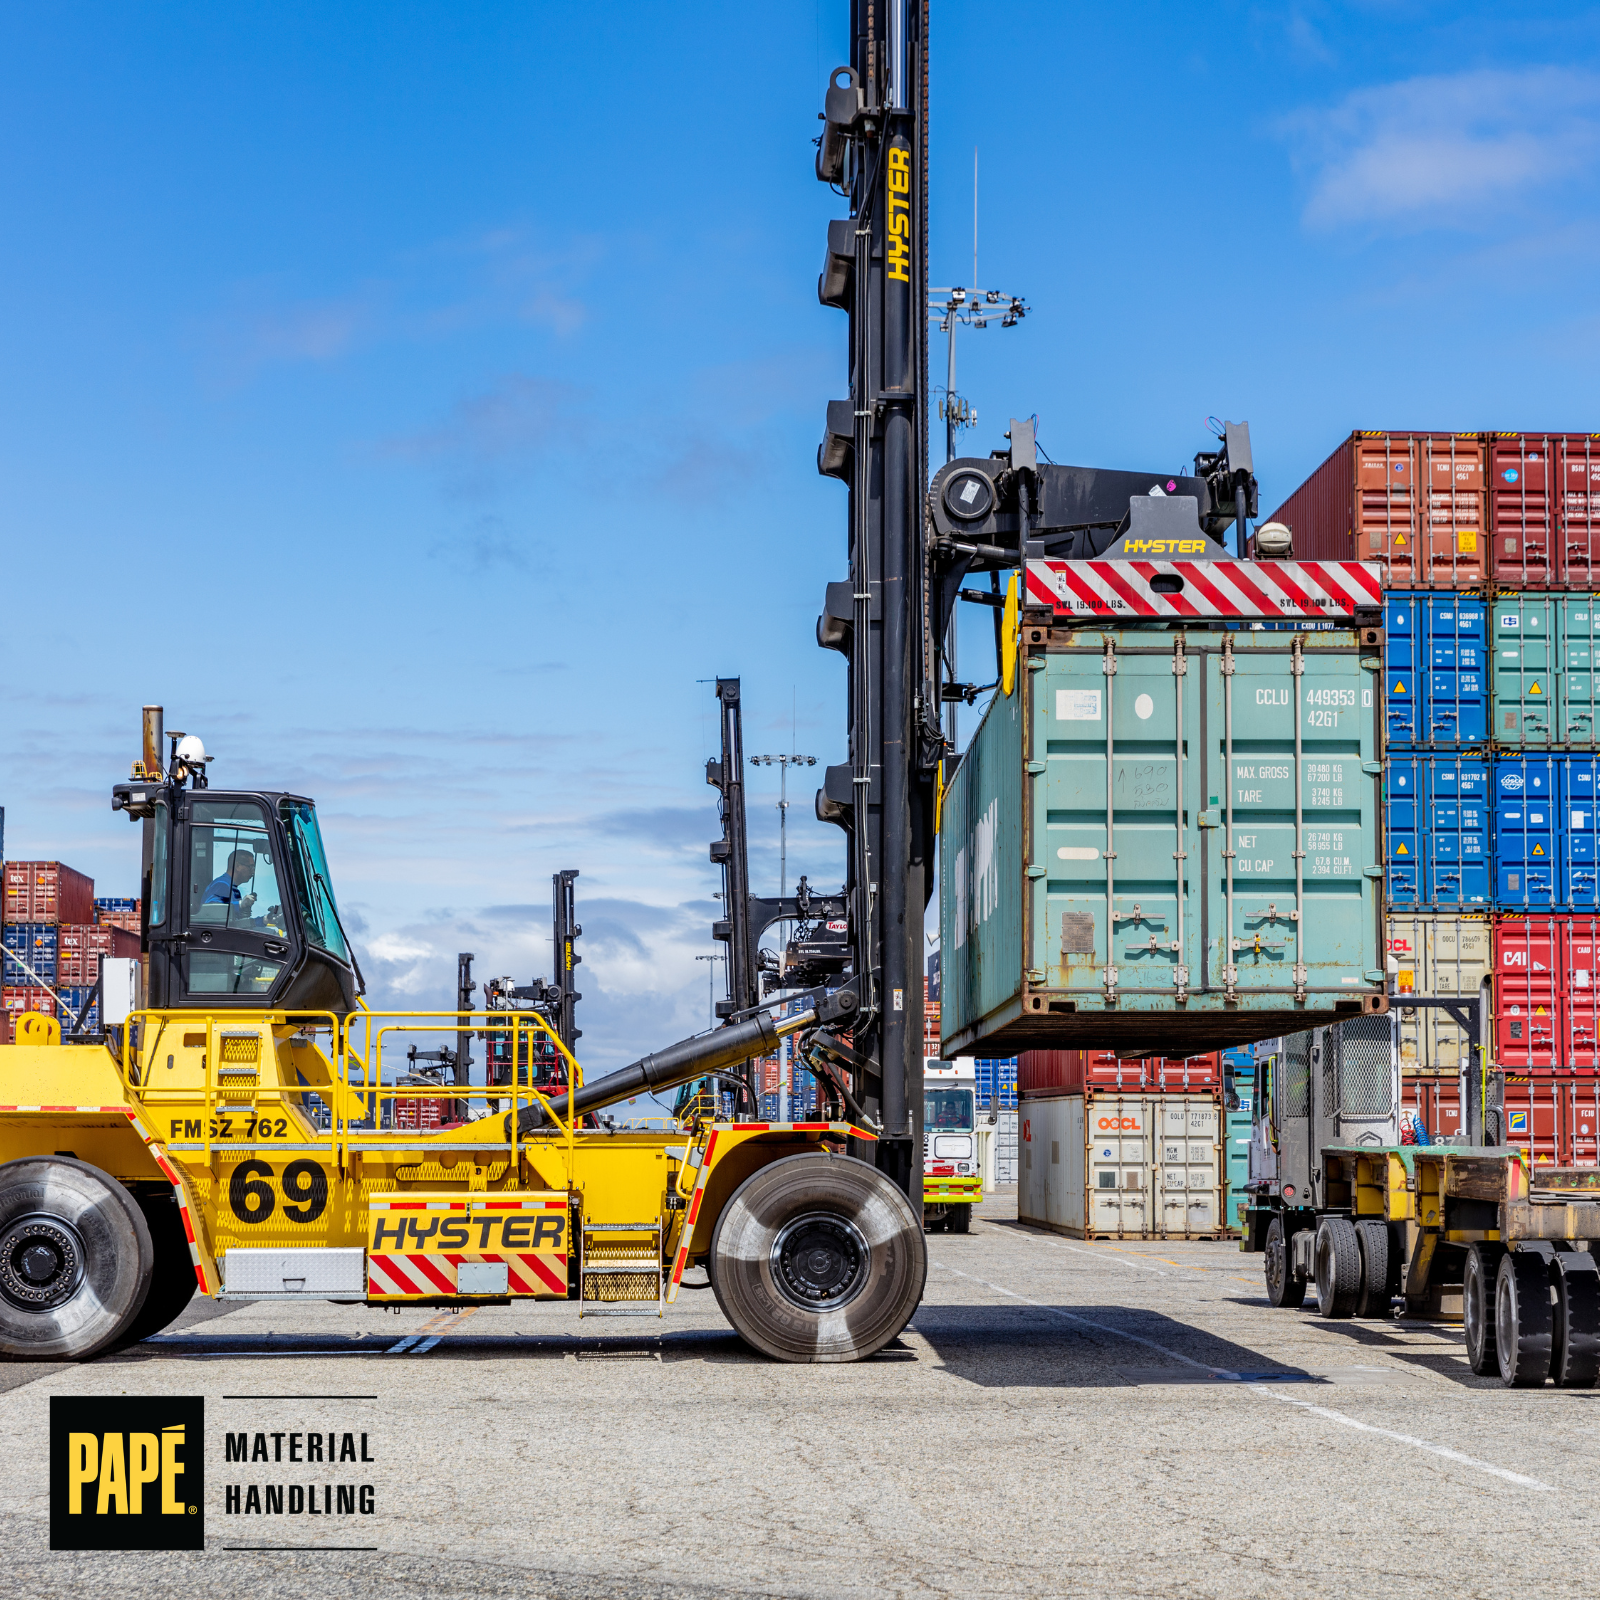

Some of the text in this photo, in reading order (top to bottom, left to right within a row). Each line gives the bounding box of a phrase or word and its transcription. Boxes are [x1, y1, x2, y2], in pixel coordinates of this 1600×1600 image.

[888, 147, 909, 282] HYSTER
[1124, 540, 1206, 553] HYSTER
[1056, 600, 1073, 610] SWL
[1256, 689, 1289, 705] CCLU
[1306, 689, 1355, 706] 449353
[1308, 711, 1338, 727] 42G1
[1237, 766, 1289, 779] MAX. GROSS
[1333, 764, 1342, 773] KG
[1333, 773, 1342, 782] LB
[1238, 790, 1262, 803] TARE
[1333, 788, 1342, 796] KG
[1333, 797, 1342, 806] LB
[1239, 835, 1257, 848] NET
[1333, 833, 1342, 841] KG
[1333, 842, 1342, 850] LB
[1255, 860, 1273, 872] CAP
[1315, 857, 1330, 865] 67.8
[10, 874, 24, 883] tex
[64, 937, 78, 946] tex
[1503, 951, 1526, 966] CAI
[170, 1118, 287, 1138] FMSZ 762
[1098, 1117, 1140, 1130] OOCL
[229, 1159, 327, 1223] 69
[373, 1215, 566, 1250] HYSTER
